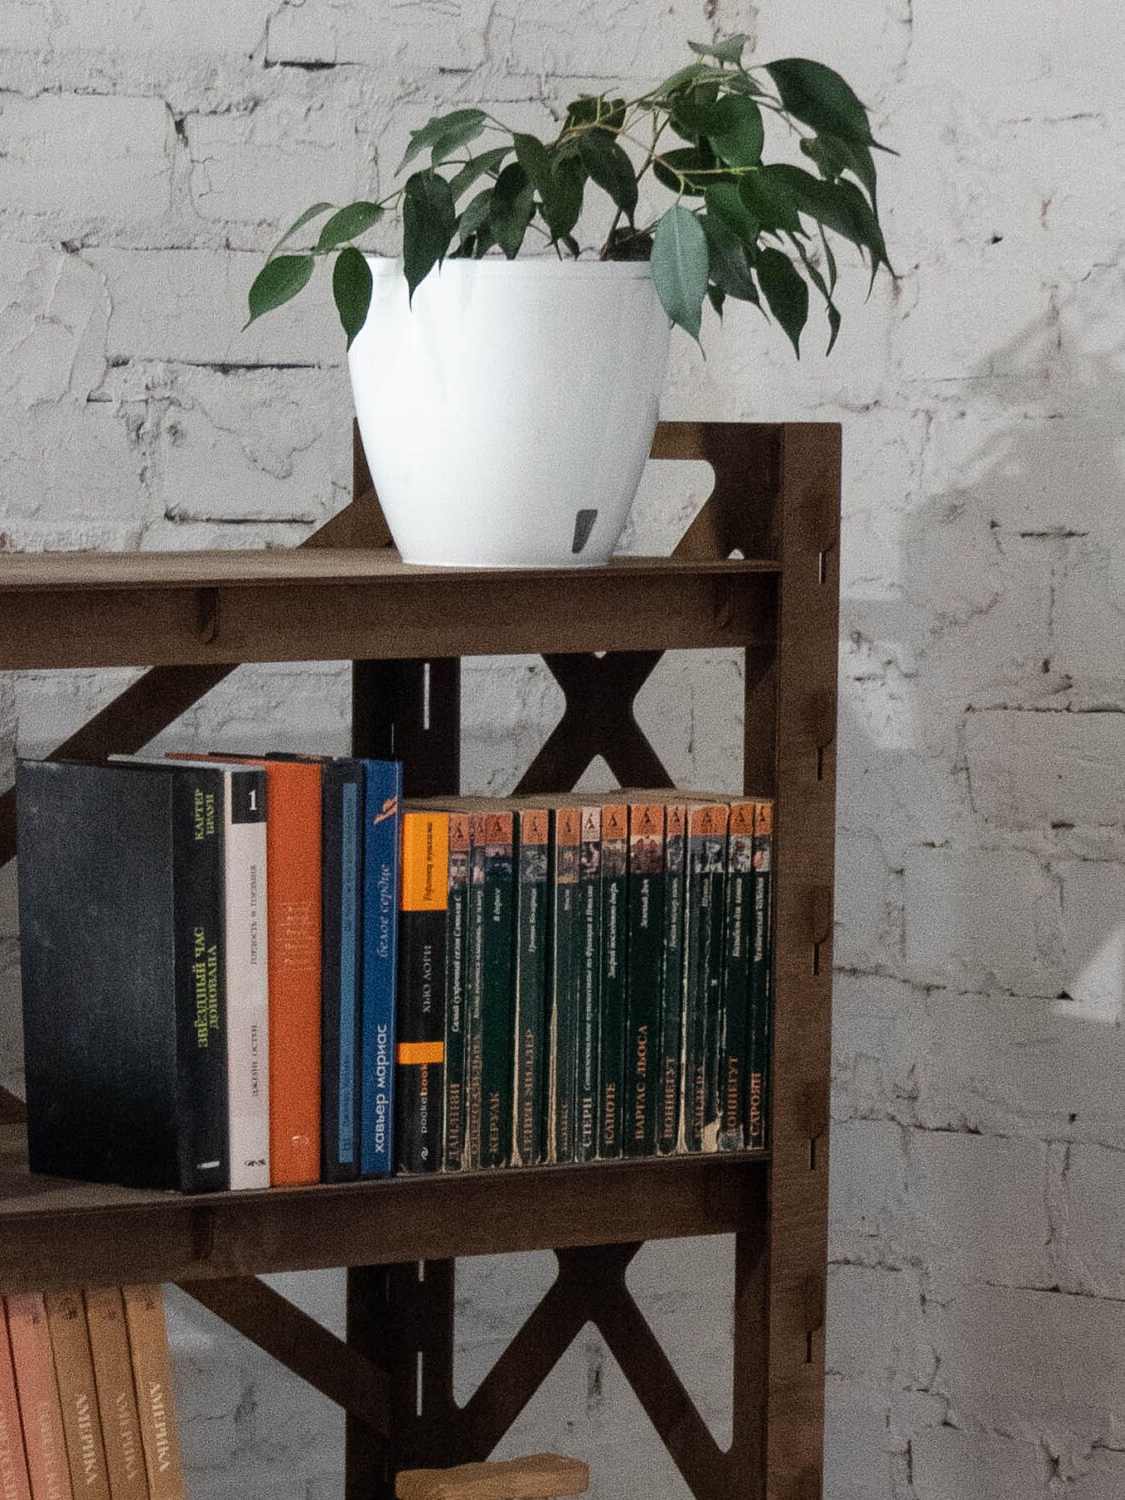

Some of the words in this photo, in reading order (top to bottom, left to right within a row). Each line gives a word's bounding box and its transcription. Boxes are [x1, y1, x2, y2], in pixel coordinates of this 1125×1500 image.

[193, 788, 206, 840] КАРТЕР
[205, 793, 216, 835] БРАУН
[248, 789, 258, 811] 1
[376, 863, 393, 912] сердце
[193, 926, 206, 958] ЧАС
[375, 915, 389, 957] белое
[191, 962, 209, 1048] ЗВЁЗДНЫЙ
[207, 945, 220, 1030] ДОНОВАНА
[375, 1023, 390, 1088] мариас
[636, 1025, 648, 1078] ЛЬОСА
[374, 1093, 390, 1153] хавьер
[489, 1092, 500, 1154] КЕРУАК
[581, 1097, 593, 1149] СТЕРН
[604, 1082, 617, 1145] КАПОТЕ
[634, 1082, 646, 1140] ВАРГАС
[663, 1055, 676, 1139] ВОННЕГУТ
[750, 1073, 761, 1137] САРОЯН
[74, 1392, 99, 1486] АМЕРИКА
[115, 1389, 139, 1481] АМЕРИКА
[149, 1379, 171, 1473] АМЕРИКА
